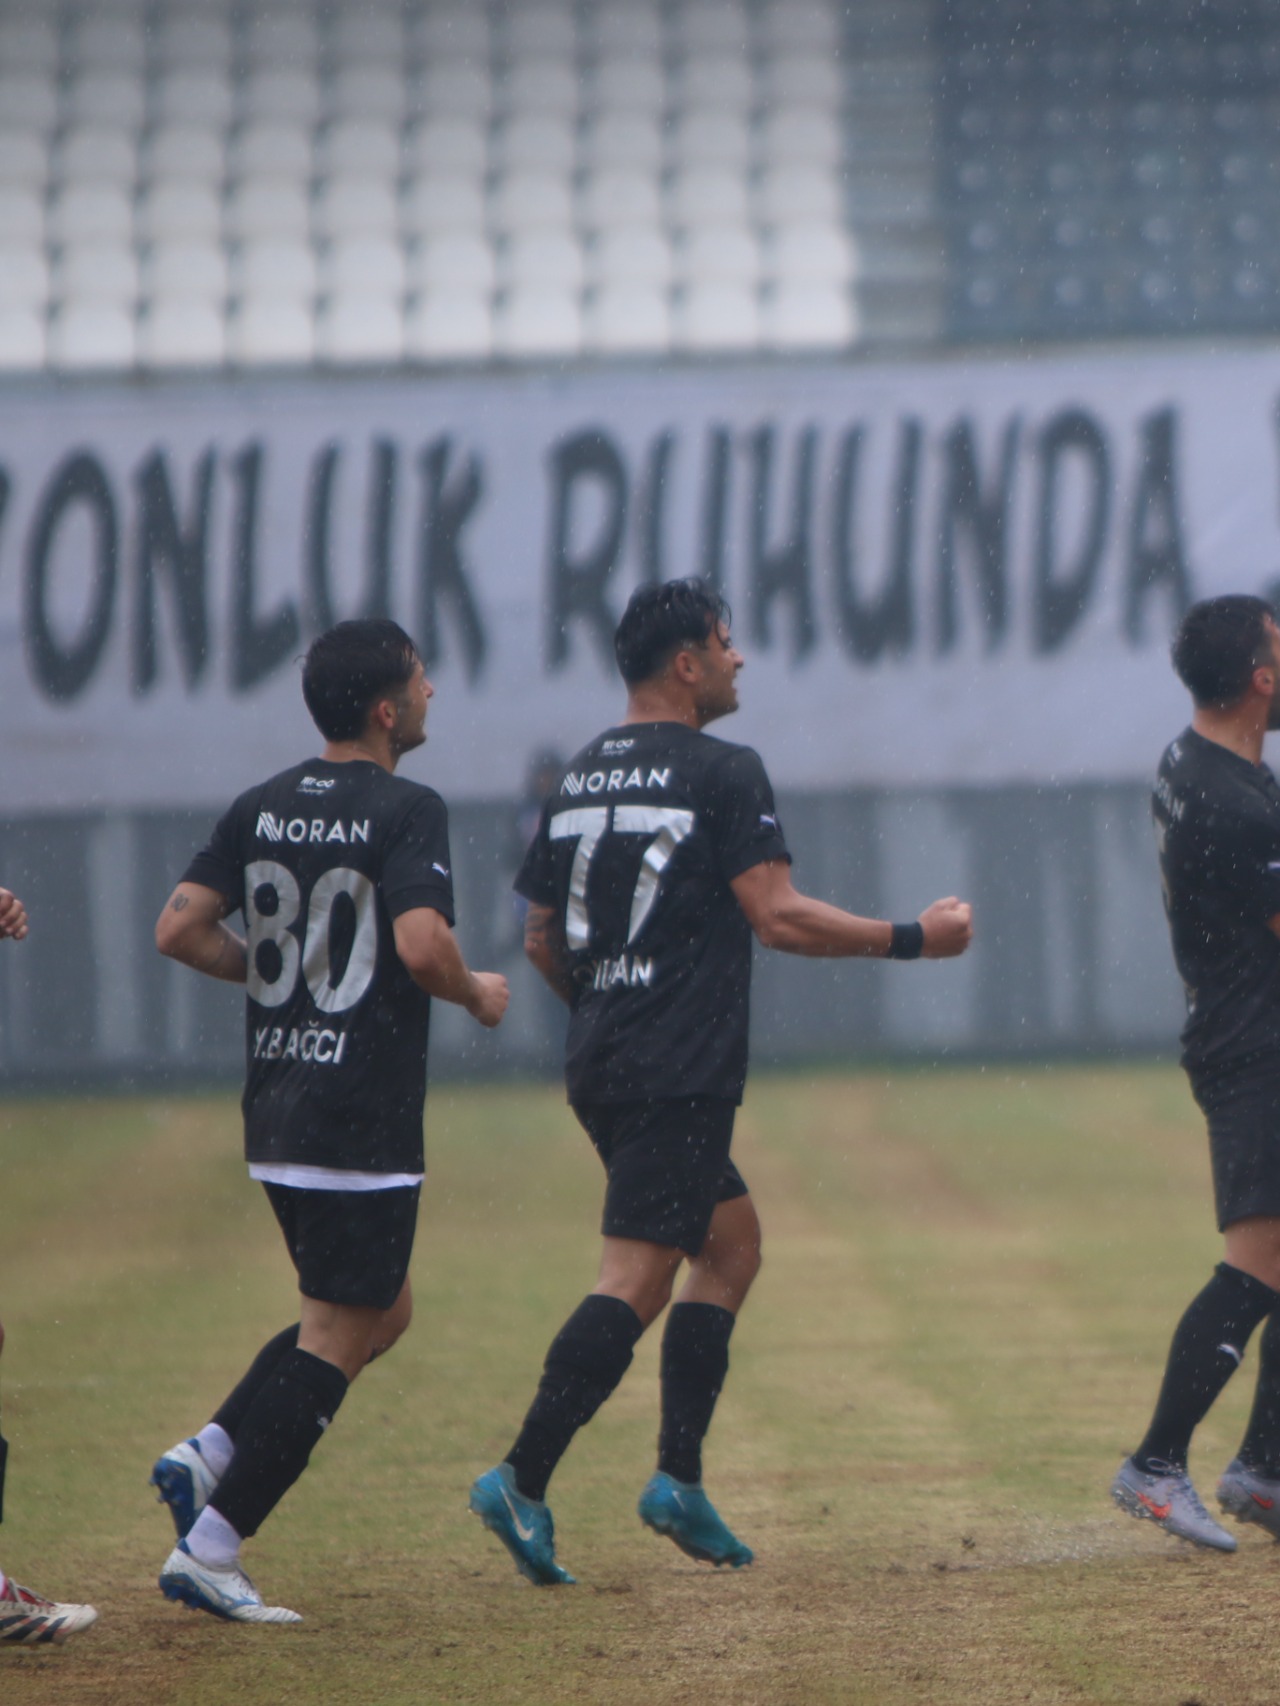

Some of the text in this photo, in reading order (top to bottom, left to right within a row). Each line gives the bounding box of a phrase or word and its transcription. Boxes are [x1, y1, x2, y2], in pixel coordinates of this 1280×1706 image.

[0, 430, 485, 706] ONLUK
[543, 405, 1200, 670] RUHUNDA
[256, 811, 370, 844] NORAN
[560, 767, 672, 797] NORAN
[245, 859, 379, 1013] 80
[549, 804, 695, 950] 77
